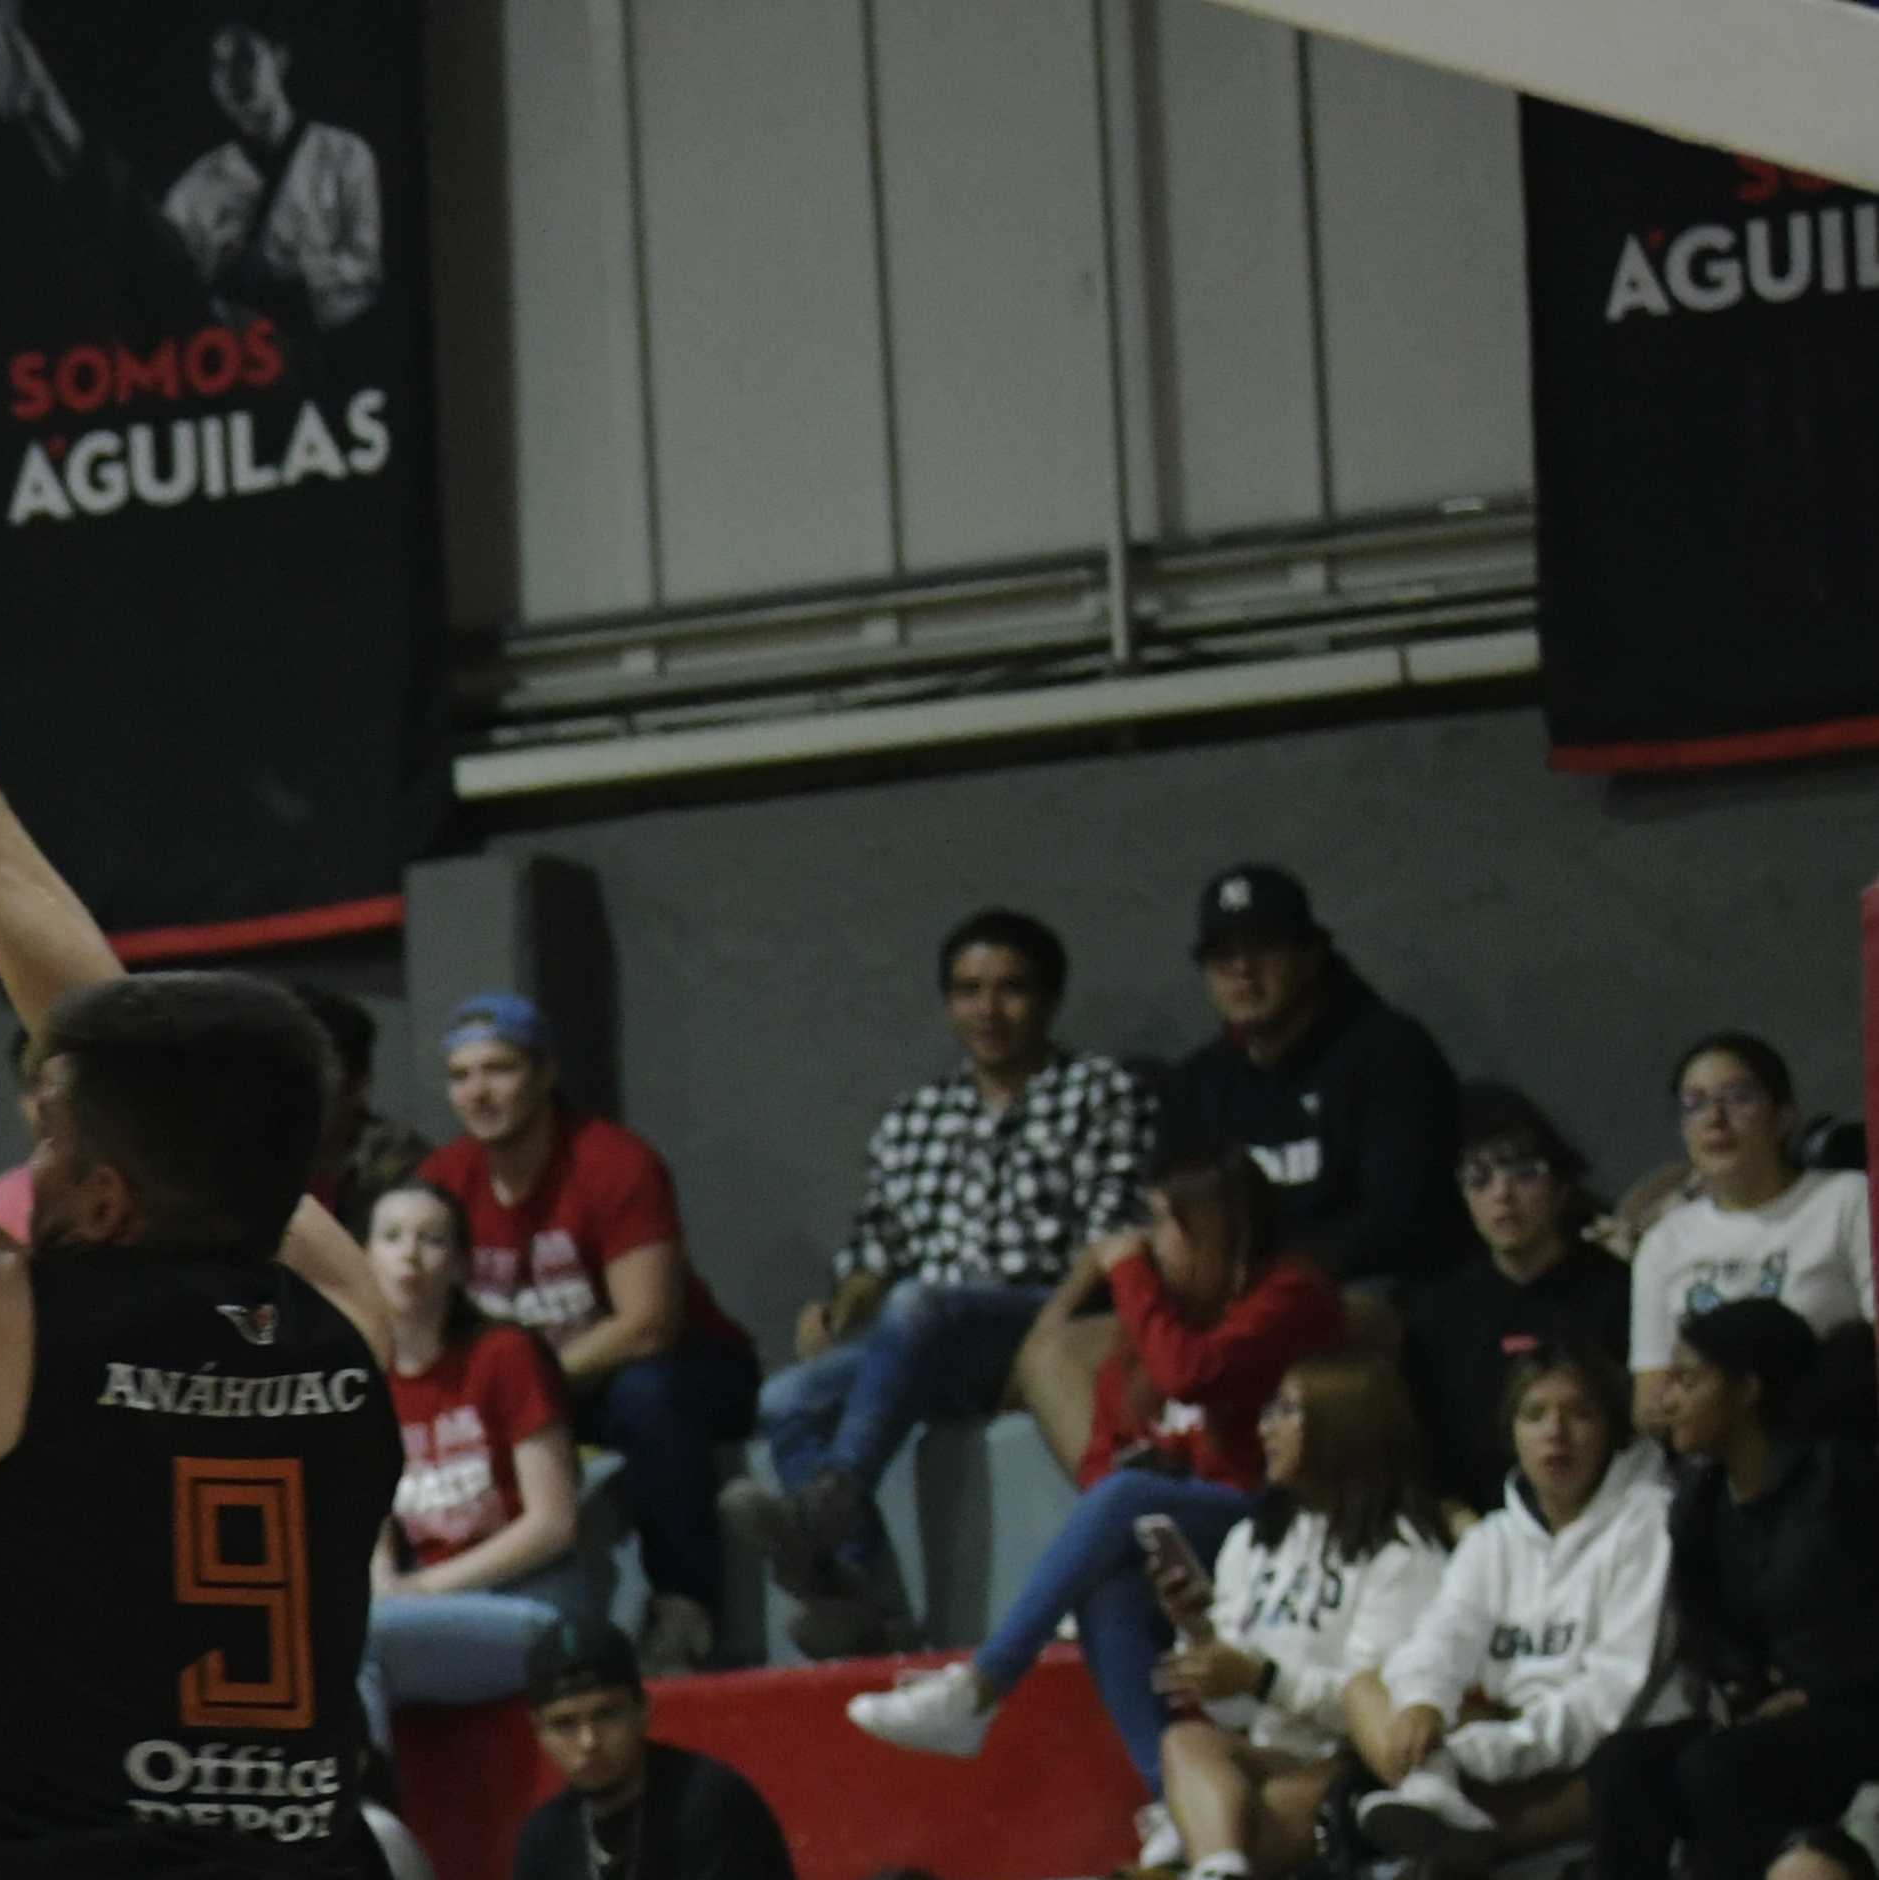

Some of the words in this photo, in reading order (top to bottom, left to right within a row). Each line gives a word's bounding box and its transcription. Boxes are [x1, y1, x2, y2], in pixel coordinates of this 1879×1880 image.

[9, 316, 285, 424] SOMOS
[96, 1360, 371, 1419] ANÁHUAC
[171, 1455, 318, 1731] 9
[121, 1738, 342, 1798] Office
